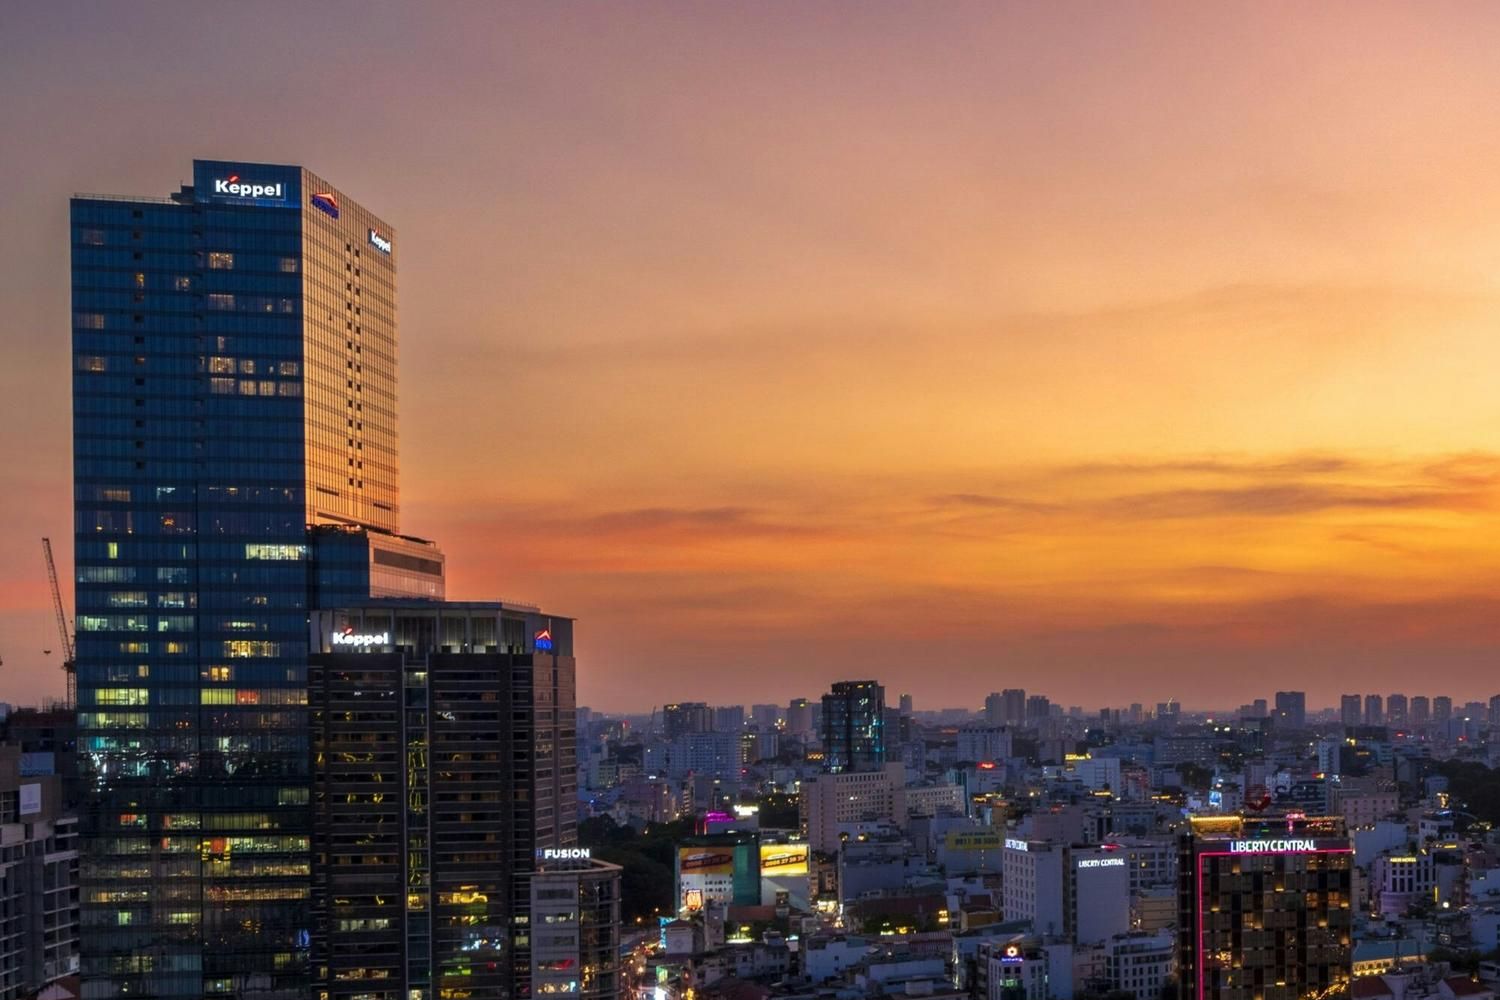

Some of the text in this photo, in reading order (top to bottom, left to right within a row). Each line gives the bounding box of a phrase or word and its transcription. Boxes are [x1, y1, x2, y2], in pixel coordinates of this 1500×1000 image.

[215, 179, 281, 197] Keppel
[333, 631, 388, 645] Keppel
[1230, 840, 1317, 852] LIBERTY CENTRAL
[544, 849, 590, 859] FUSION
